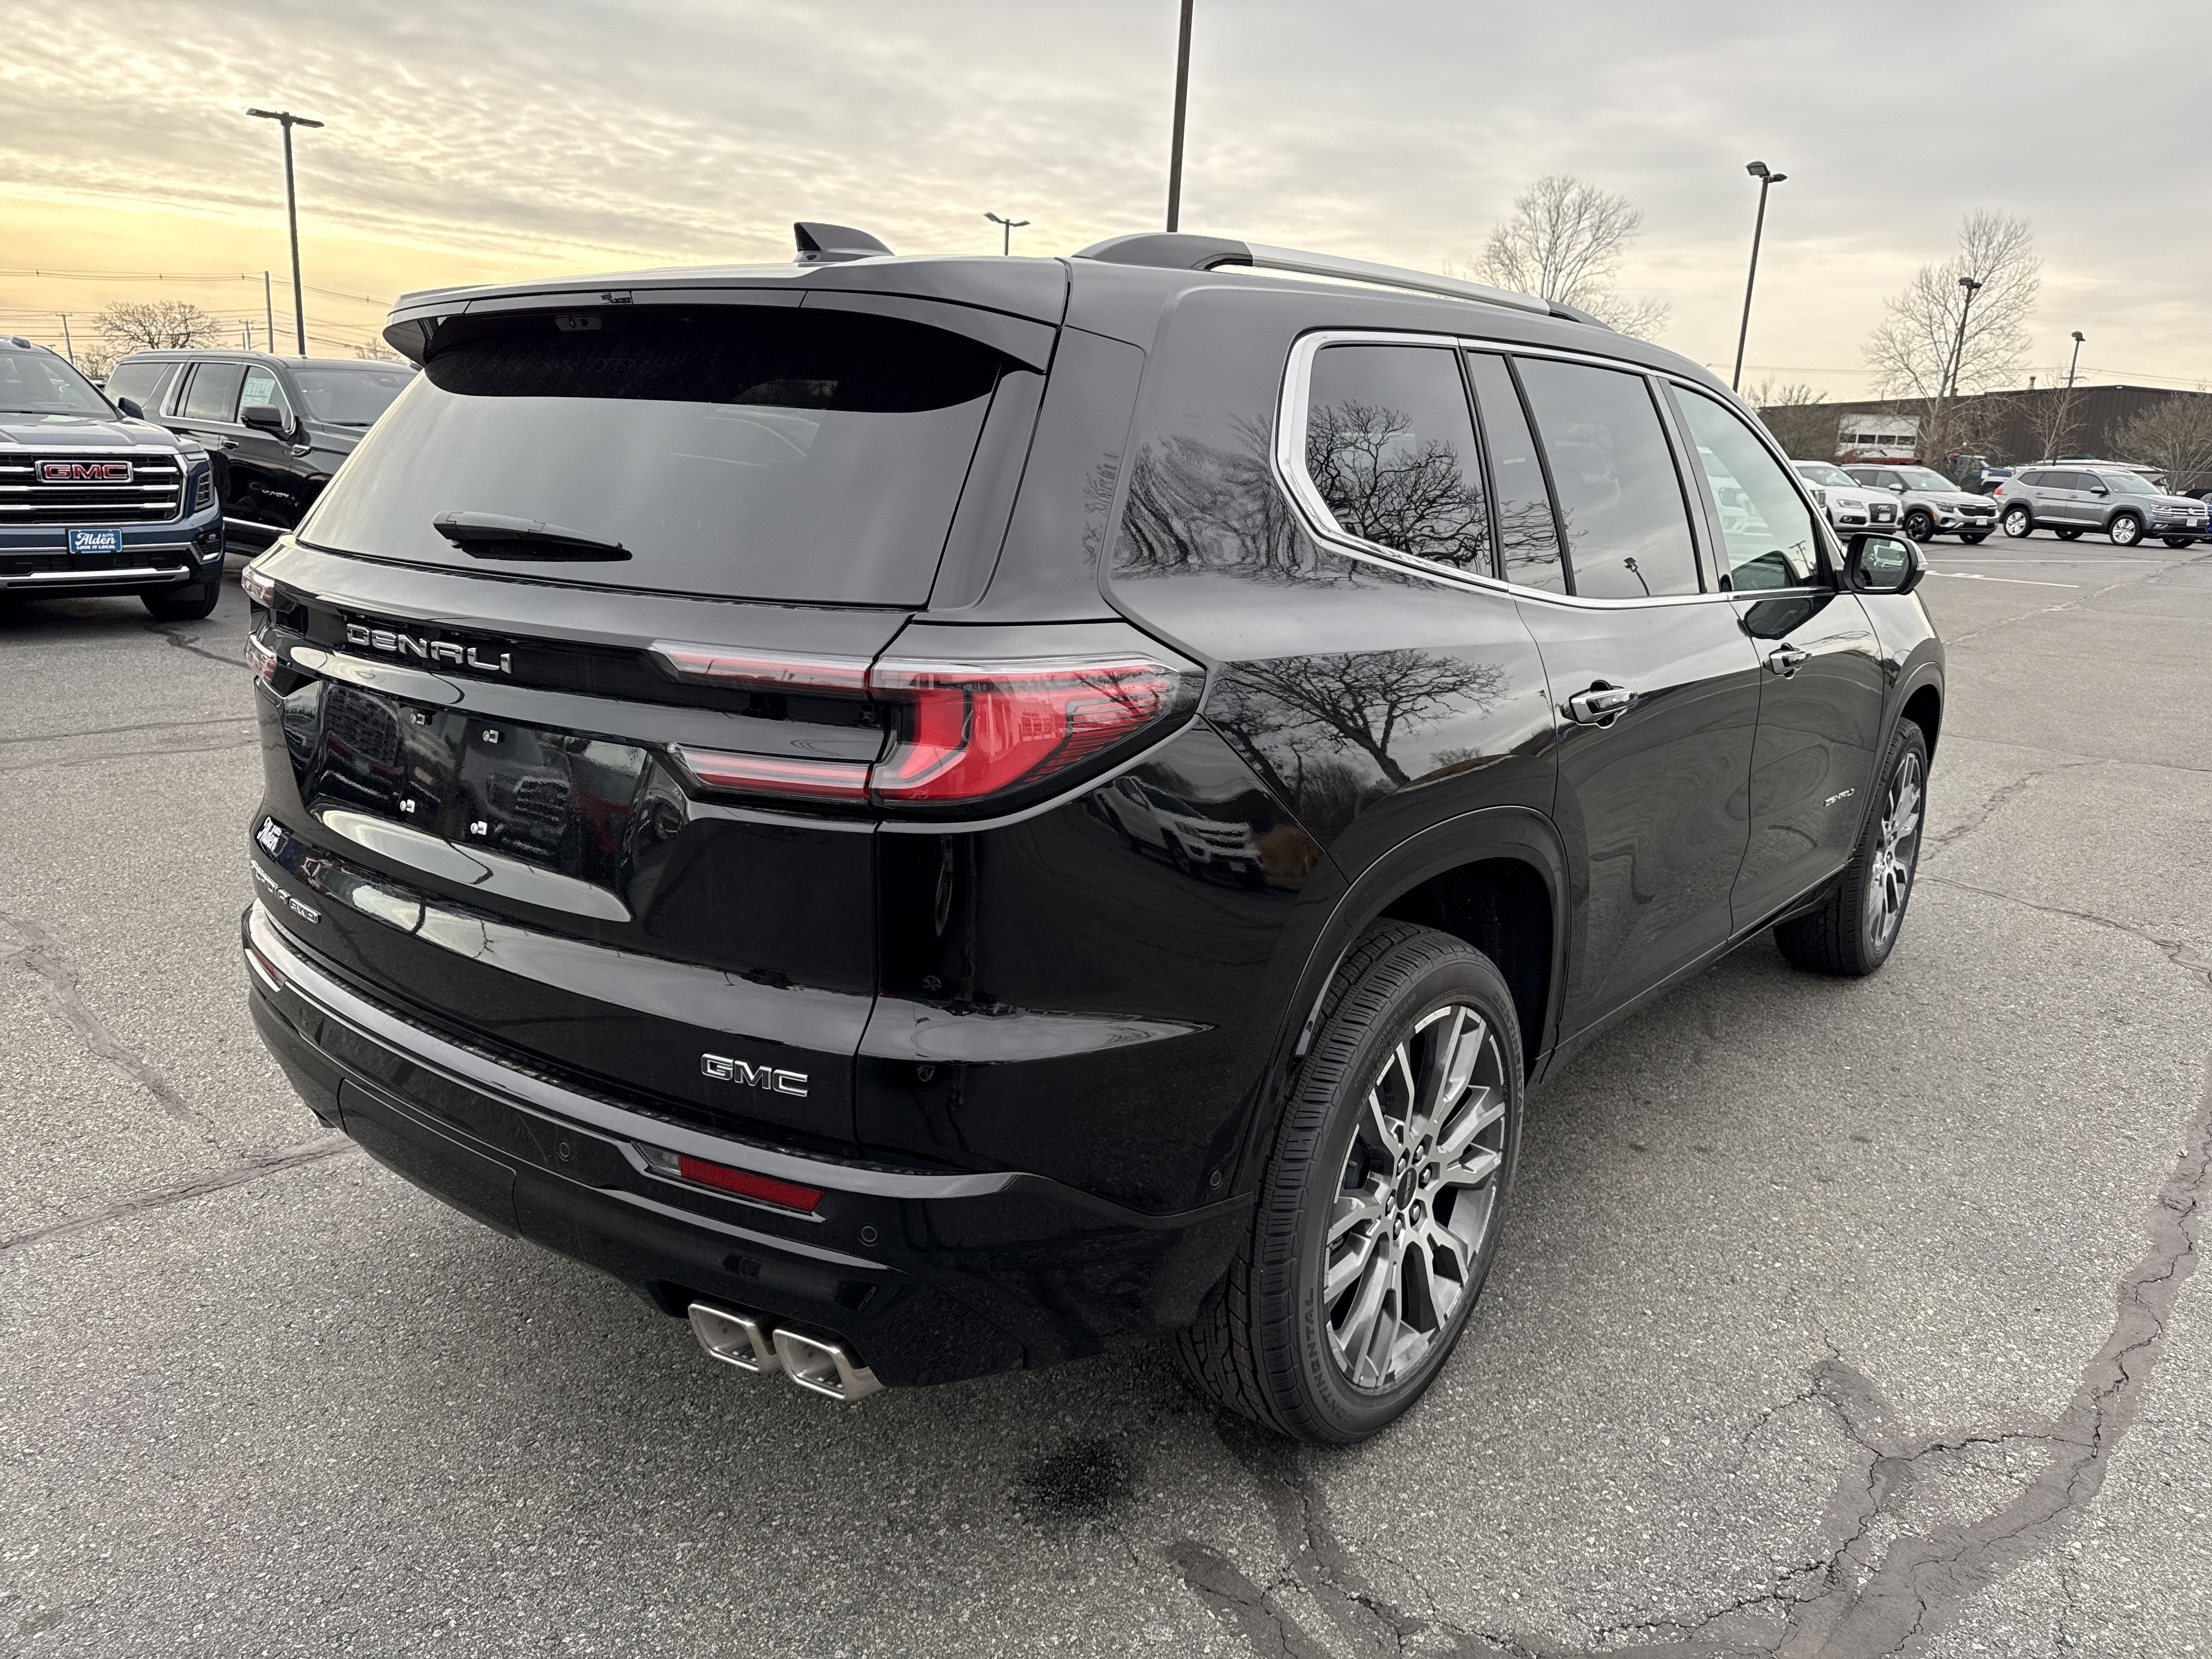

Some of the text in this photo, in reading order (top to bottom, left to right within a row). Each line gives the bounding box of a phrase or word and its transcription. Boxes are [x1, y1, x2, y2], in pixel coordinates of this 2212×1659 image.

[44, 464, 127, 479] GMC
[75, 532, 116, 545] Alden
[346, 623, 513, 674] DENALI
[701, 1053, 809, 1097] GMC
[1305, 1288, 1357, 1424] CONTINENTAL
